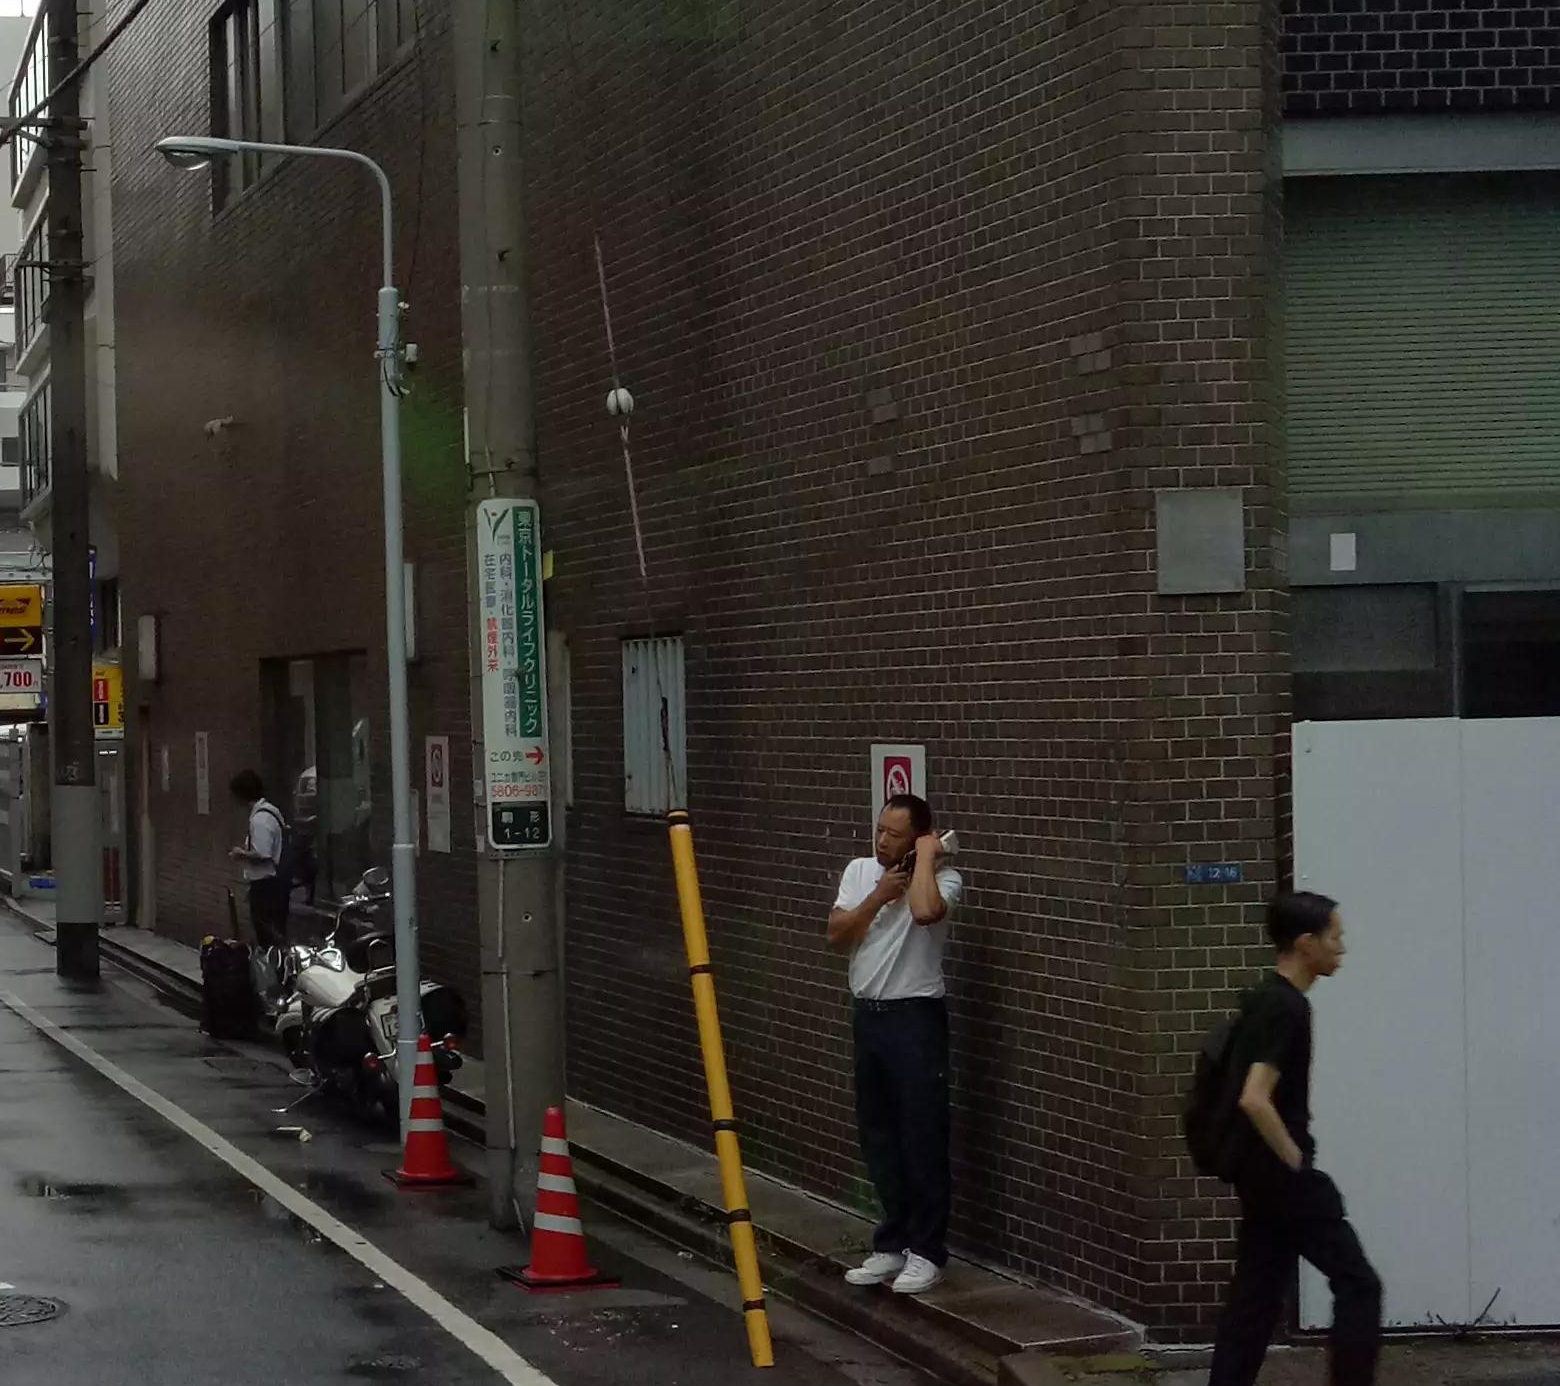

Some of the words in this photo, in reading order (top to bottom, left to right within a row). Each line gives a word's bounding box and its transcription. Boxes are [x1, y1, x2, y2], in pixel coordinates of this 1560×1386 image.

[517, 510, 538, 735] 東京トータルライフクリニック
[490, 750, 523, 762] この先
[504, 827, 540, 839] 1-12
